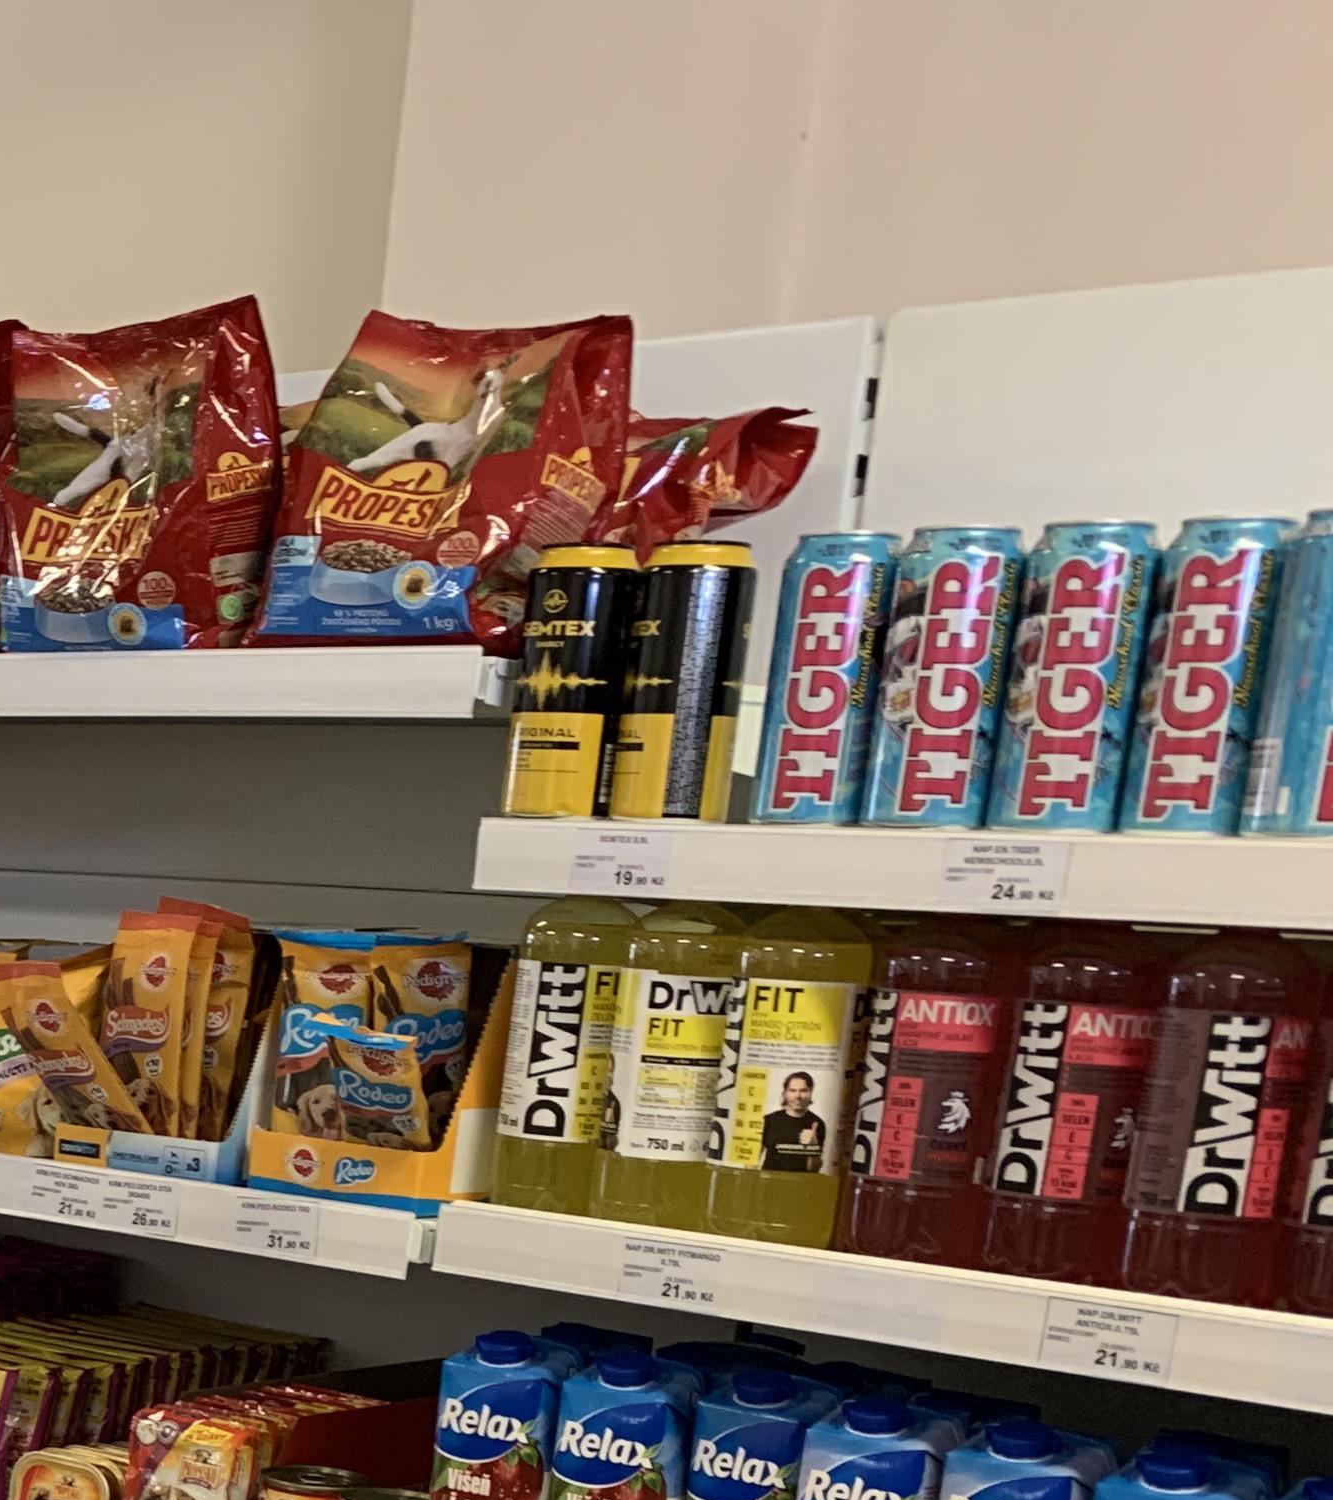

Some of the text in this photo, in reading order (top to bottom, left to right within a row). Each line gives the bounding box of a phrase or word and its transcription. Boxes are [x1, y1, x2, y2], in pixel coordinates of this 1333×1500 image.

[769, 562, 859, 813] TIGER
[894, 553, 1005, 815] TIGER
[1016, 549, 1129, 820] TIGER
[1137, 546, 1256, 822] TIGER
[594, 971, 619, 996] FI
[752, 985, 804, 1014] FIT
[648, 1018, 684, 1037] FIT
[899, 998, 995, 1027] ANTIOX
[522, 963, 588, 1137] DrWitt
[338, 1070, 408, 1107] Rodeo
[994, 1002, 1070, 1194] DrWitt
[1180, 1015, 1271, 1214] DrWitt
[336, 1158, 376, 1183] Rodeo
[647, 1139, 669, 1151] 750
[438, 1397, 530, 1445] Relax
[559, 1419, 654, 1470] Relax
[693, 1438, 787, 1490] Relax
